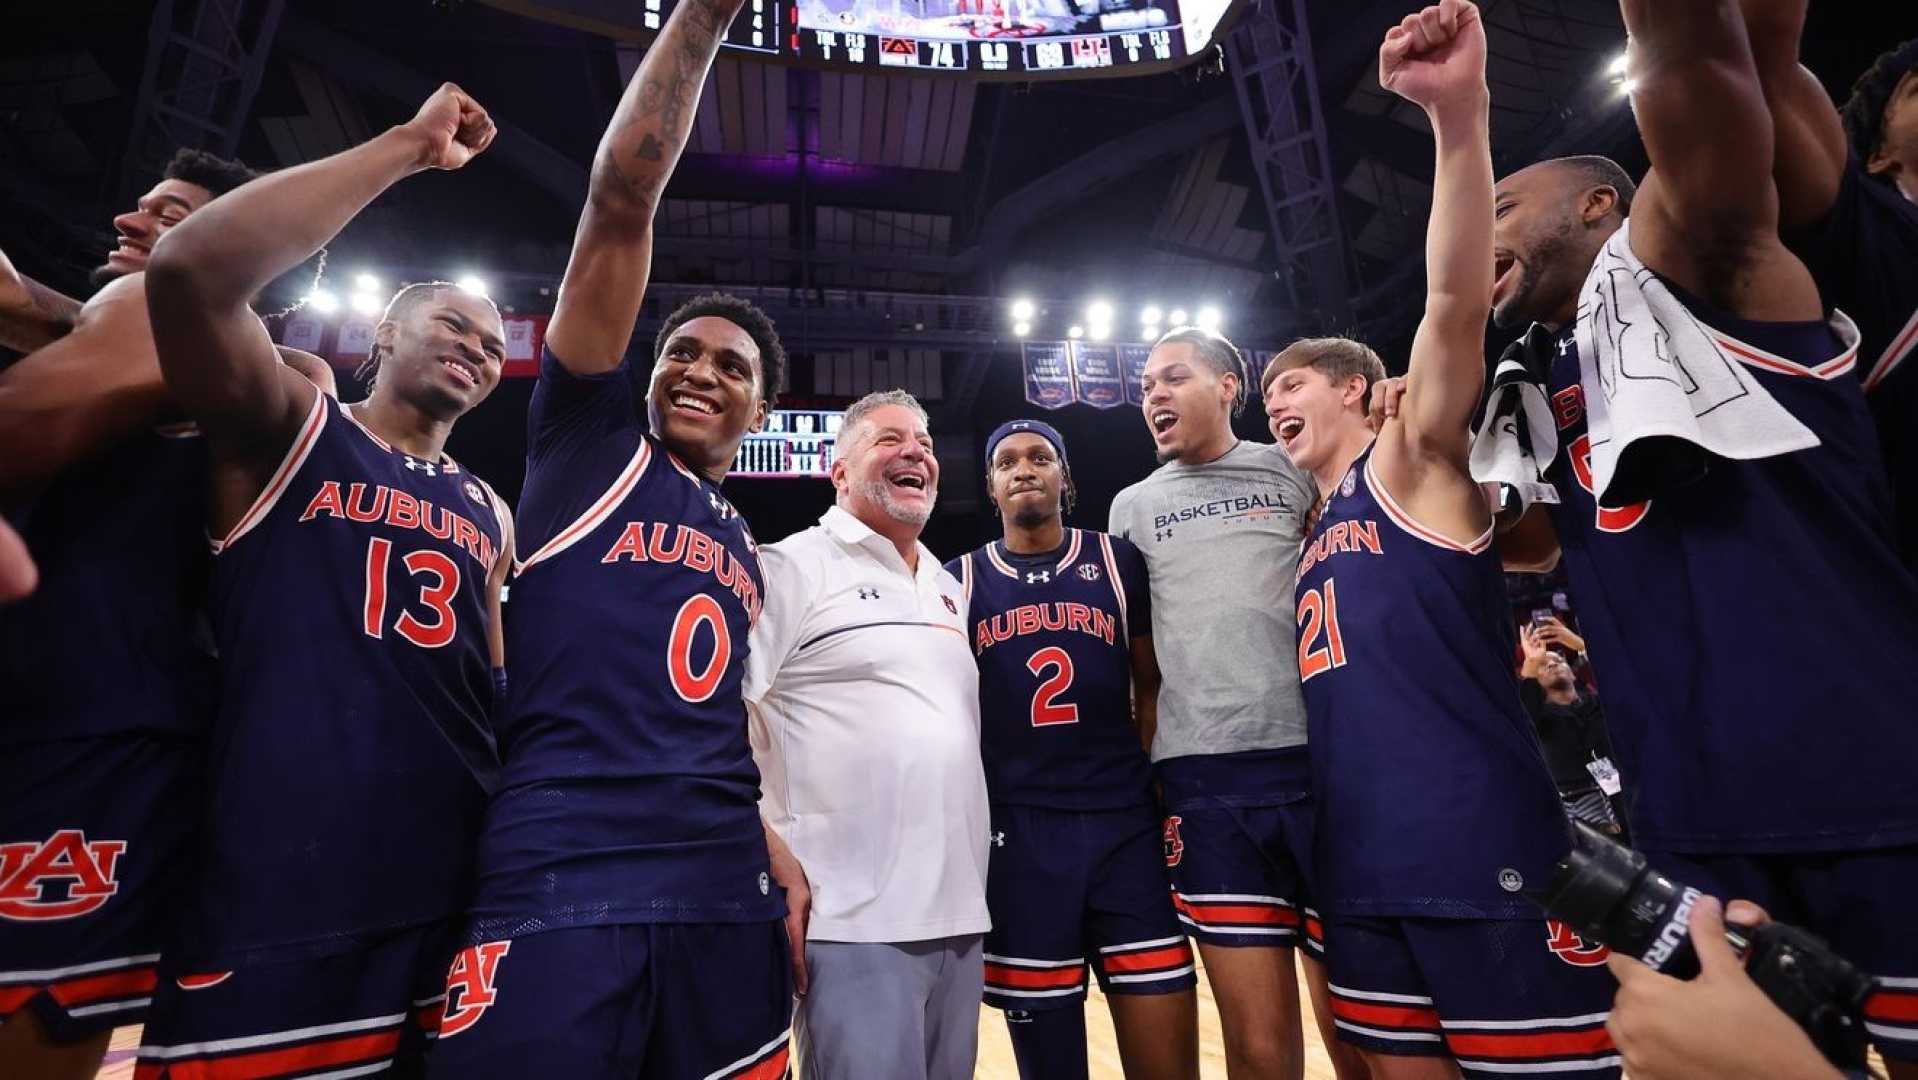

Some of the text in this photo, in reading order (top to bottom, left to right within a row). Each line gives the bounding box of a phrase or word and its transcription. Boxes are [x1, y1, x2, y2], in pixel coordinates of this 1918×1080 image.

[928, 42, 955, 67] 74
[298, 481, 498, 586] AUBURN
[1155, 493, 1292, 529] BASKETBALL
[1078, 563, 1100, 581] SEC
[1296, 520, 1384, 586] BURN
[364, 536, 461, 648] 13
[667, 593, 732, 703] 0
[976, 602, 1116, 656] AUBURN
[1297, 577, 1347, 683] 21
[1026, 646, 1080, 727] 2
